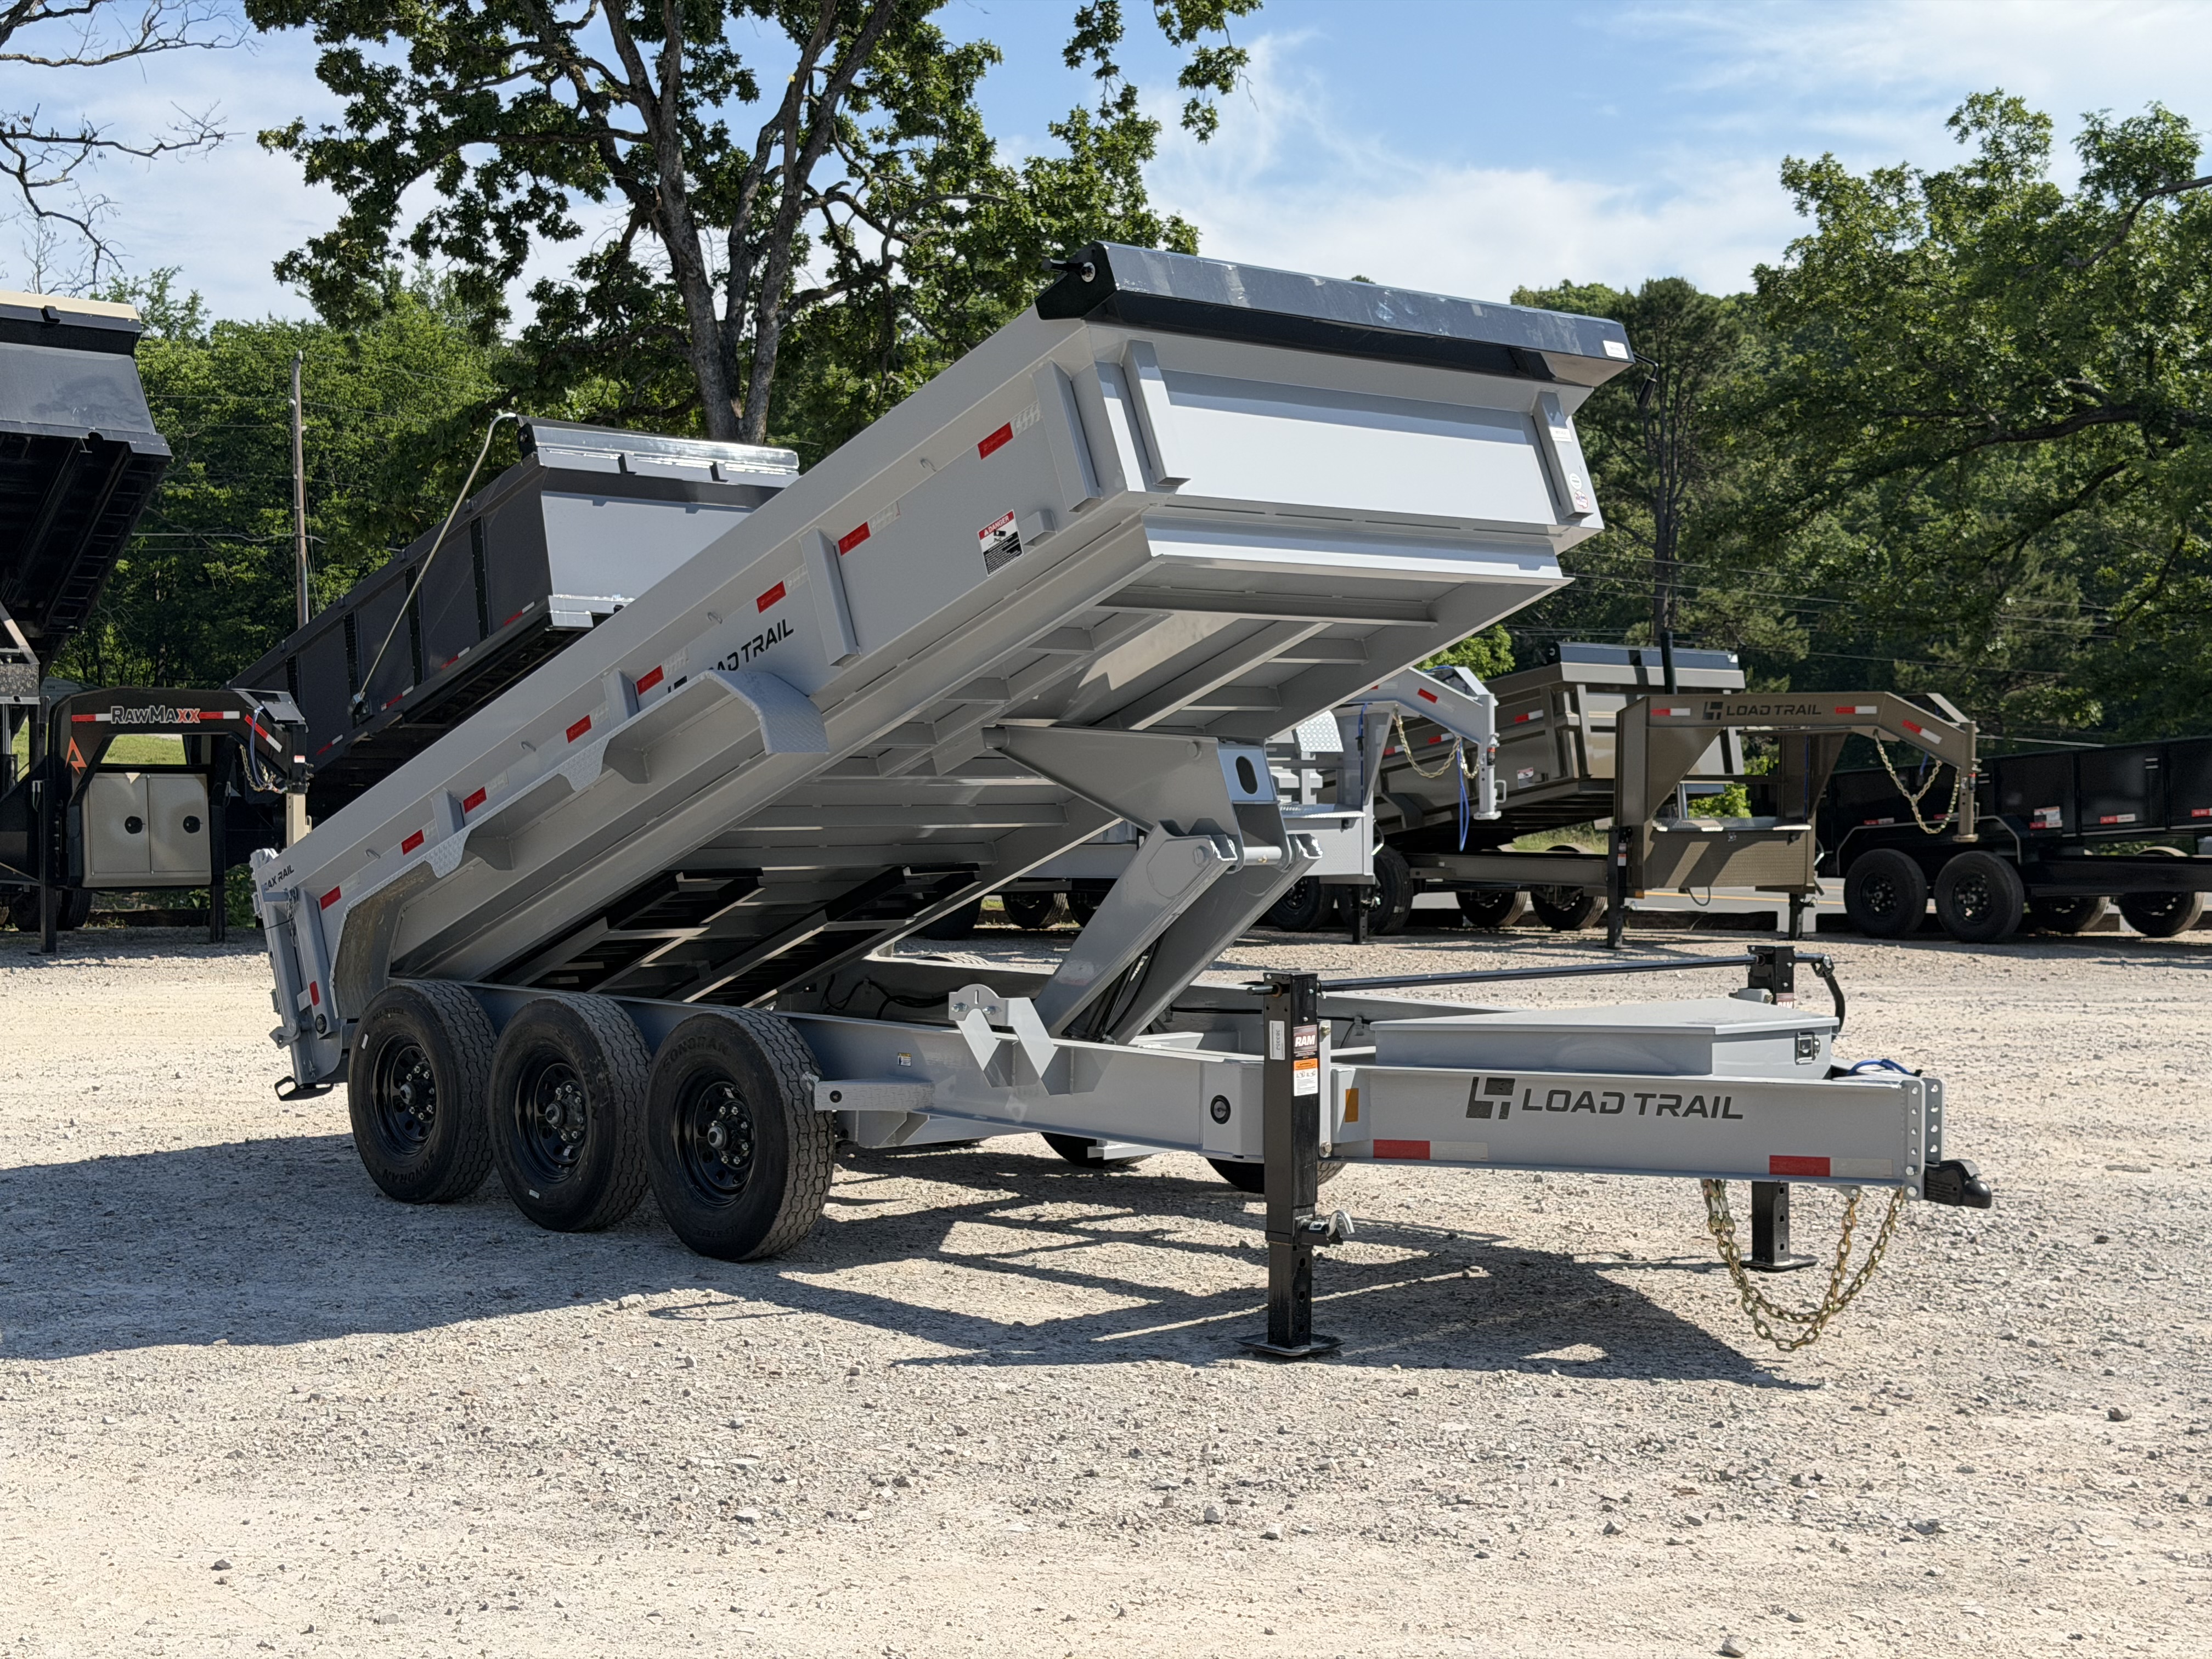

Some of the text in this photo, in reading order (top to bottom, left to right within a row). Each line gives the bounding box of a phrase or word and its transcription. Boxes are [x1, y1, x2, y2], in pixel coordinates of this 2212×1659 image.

[988, 515, 1009, 533] DANGER
[741, 618, 794, 663] TRAIL
[1726, 705, 1771, 716] LOAD
[1774, 704, 1822, 715] TRAIL
[278, 865, 295, 882] RAIL
[1295, 1035, 1316, 1047] RAM
[1522, 1088, 1626, 1114] LOAD
[1633, 1092, 1743, 1120] TRAIL
